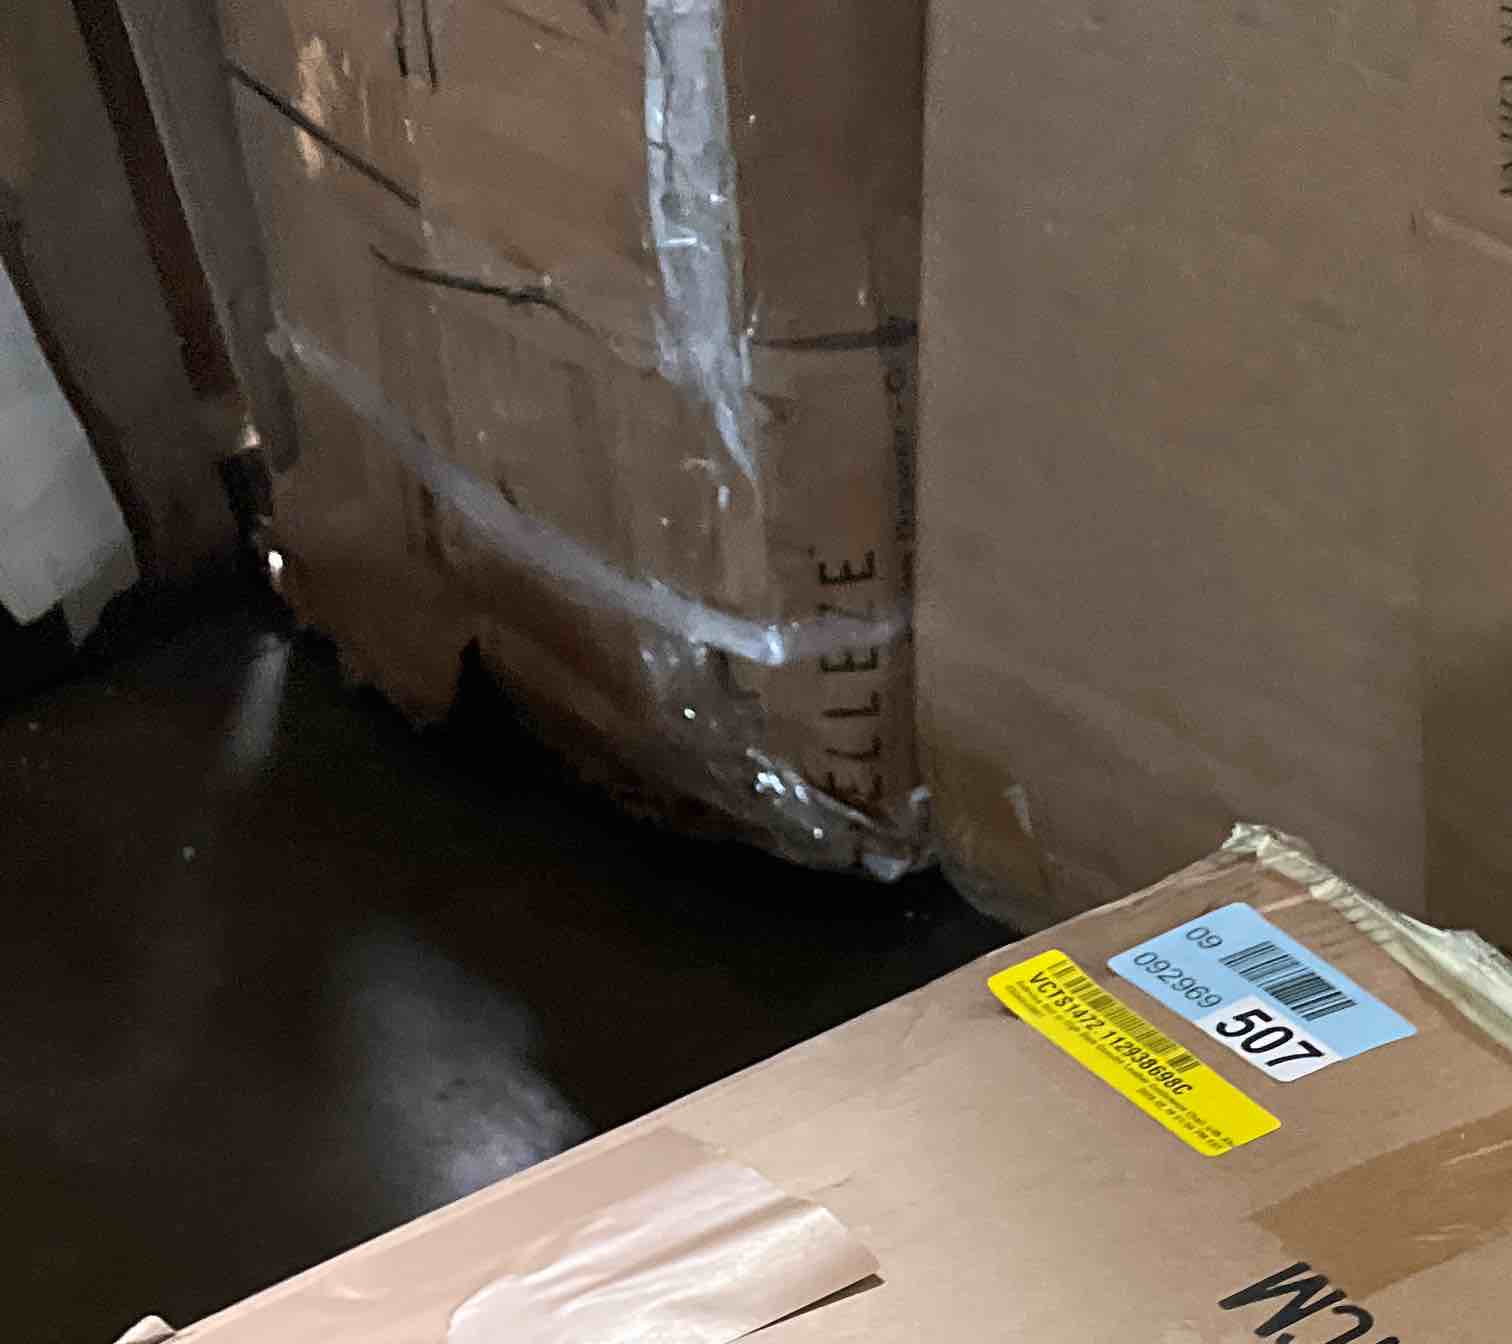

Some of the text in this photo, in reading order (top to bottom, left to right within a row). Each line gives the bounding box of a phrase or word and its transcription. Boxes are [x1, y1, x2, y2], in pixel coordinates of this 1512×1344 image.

[1185, 925, 1225, 951] 09
[1132, 951, 1223, 1010] 092969
[1214, 1006, 1324, 1071] 507
